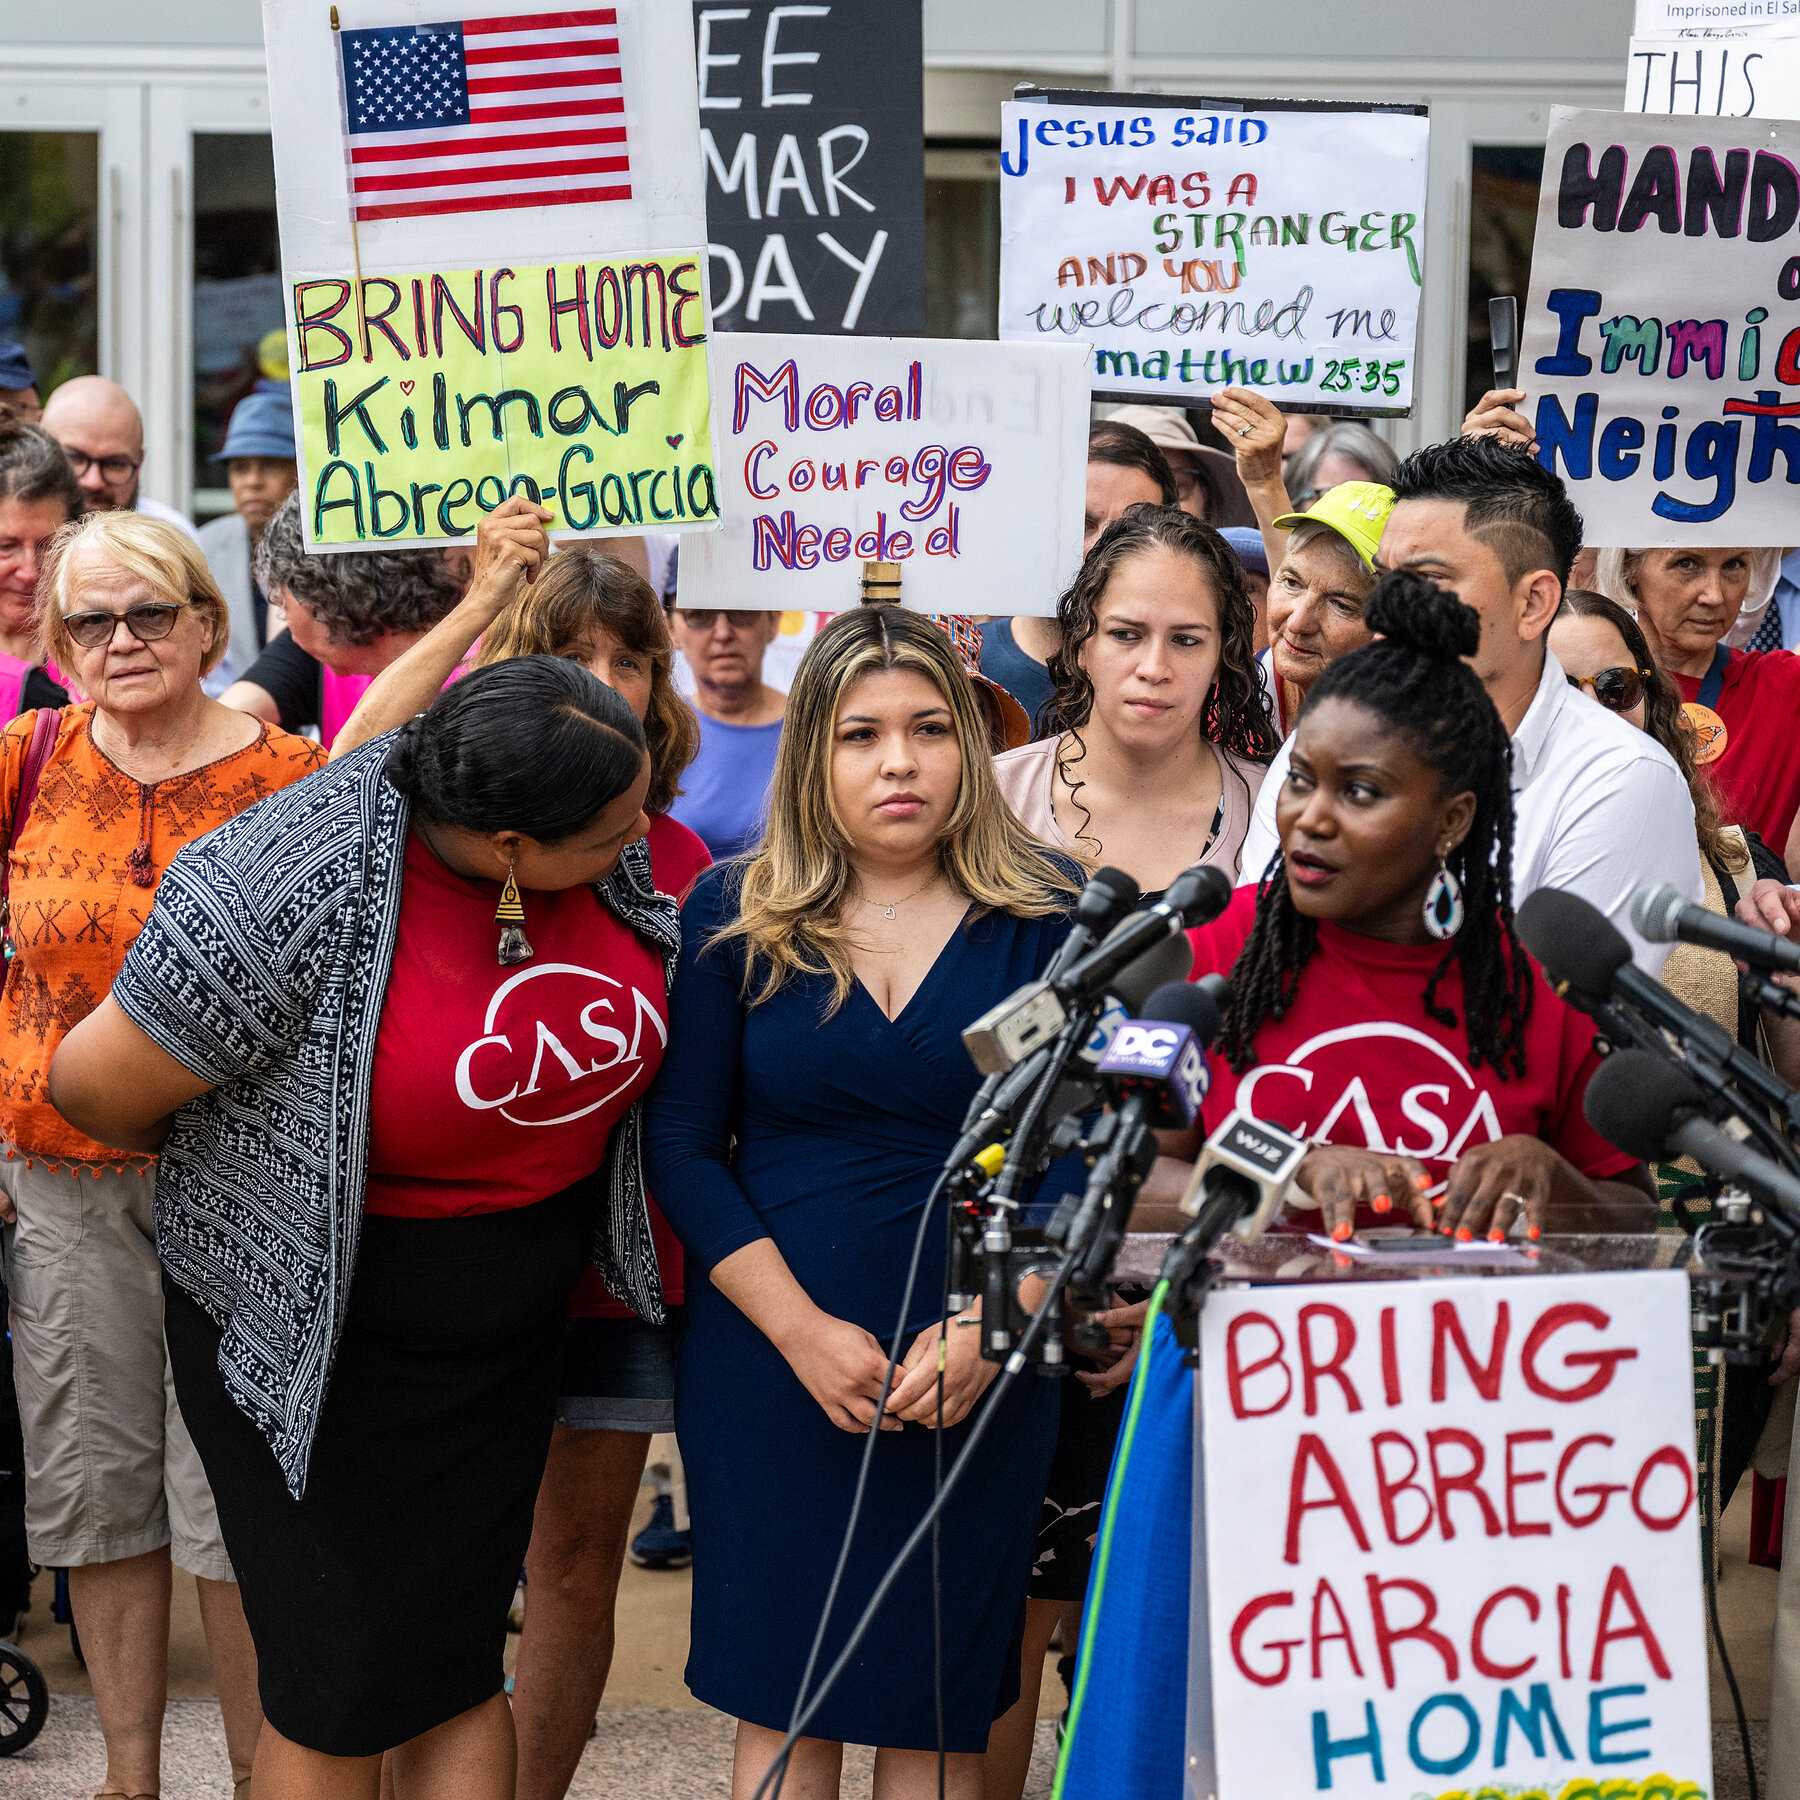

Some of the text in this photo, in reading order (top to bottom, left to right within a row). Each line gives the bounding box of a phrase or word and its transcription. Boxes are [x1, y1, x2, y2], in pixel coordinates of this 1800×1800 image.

[1667, 3, 1747, 18] Imprisoned
[1750, 3, 1762, 15] in
[1767, 1, 1778, 14] El
[1634, 49, 1763, 117] THIS
[1064, 171, 1259, 208] I WAS A
[1056, 252, 1148, 288] AND
[1153, 211, 1422, 286] STRANGER
[294, 262, 707, 373] BRING HOME
[1026, 285, 1400, 343] welcomed me
[323, 373, 660, 456] Kilmar
[732, 358, 922, 434] Moral
[1319, 357, 1406, 397] 25:35
[744, 440, 992, 522] Courage
[752, 502, 961, 571] Needed
[455, 986, 668, 1110] CASA
[1112, 1026, 1179, 1059] DC
[1235, 1064, 1503, 1163] CASA
[1226, 1299, 1639, 1420] BRING
[1283, 1427, 1698, 1565] ABREGO
[1230, 1565, 1673, 1690] GARCIA
[1311, 1683, 1652, 1790] HOME
